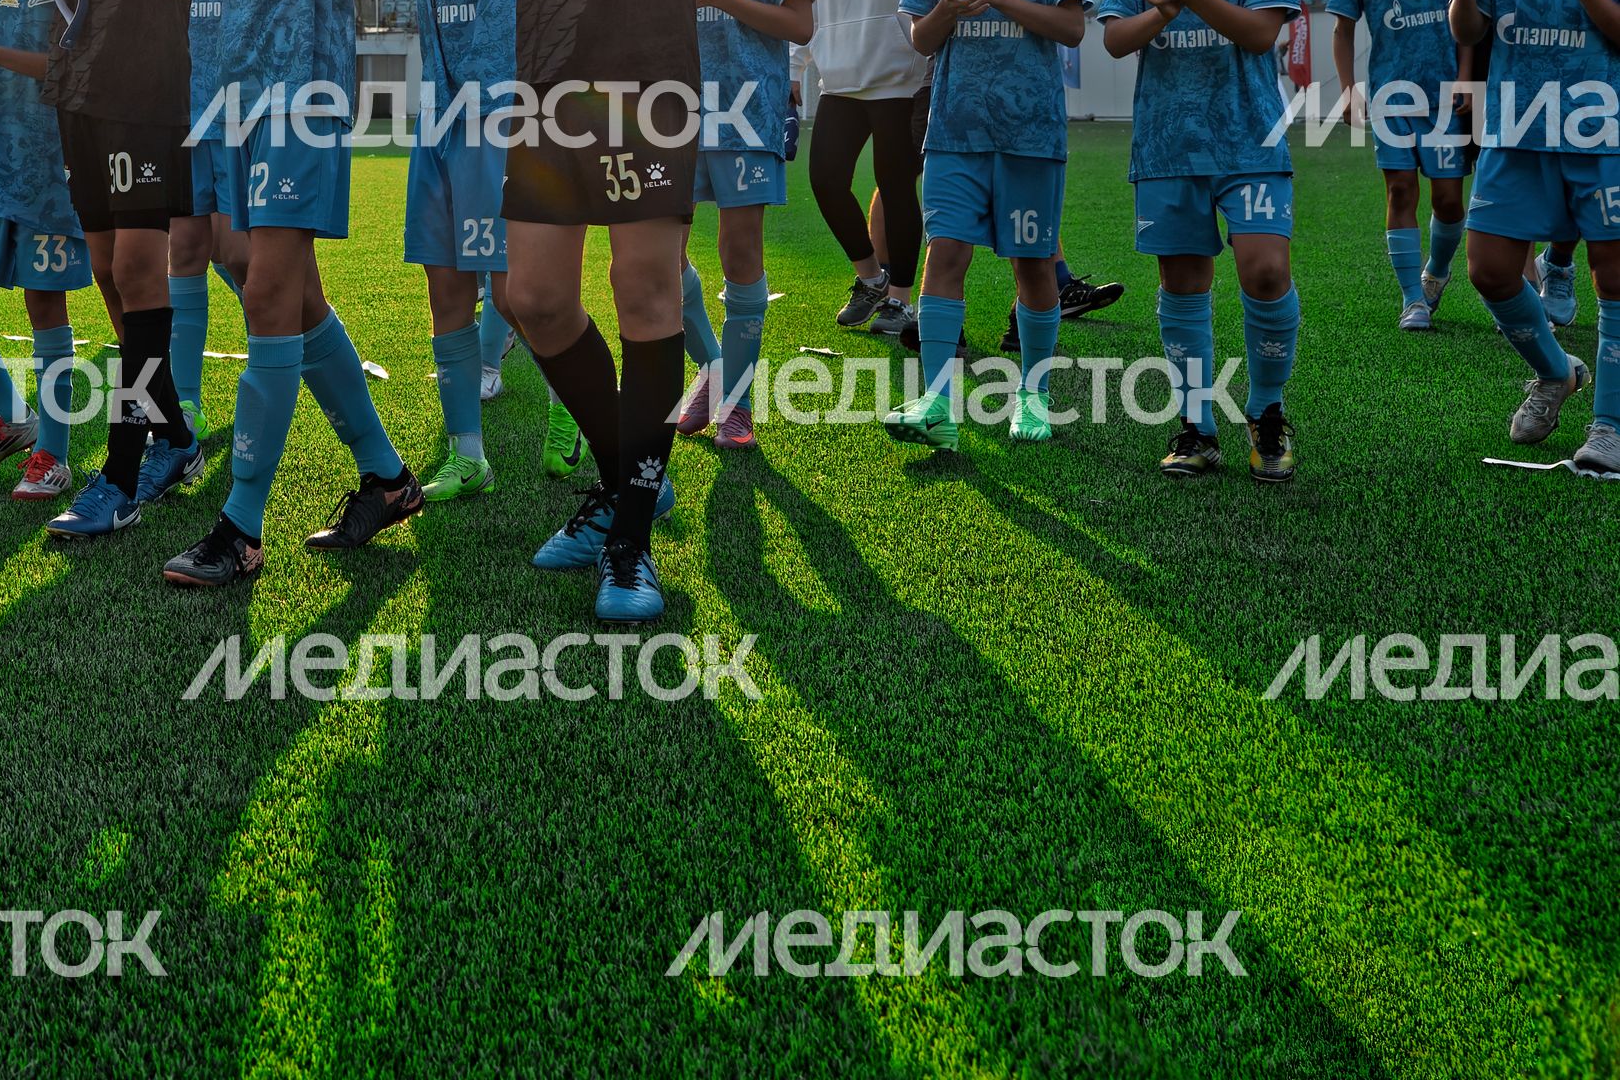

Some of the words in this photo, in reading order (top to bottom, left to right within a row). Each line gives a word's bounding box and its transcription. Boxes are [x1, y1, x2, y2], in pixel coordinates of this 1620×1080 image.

[956, 20, 1025, 39] ГАЗПРОМ
[1515, 27, 1587, 49] ГАЗПРОМ
[1433, 144, 1457, 170] 12
[136, 176, 162, 184] KELME
[599, 152, 642, 202] 35
[643, 179, 673, 190] KELME
[735, 156, 749, 192] 2
[1239, 183, 1276, 221] 14
[462, 217, 496, 257] 23
[1009, 208, 1040, 245] 16
[32, 234, 68, 273] 33
[630, 477, 661, 491] KELME
